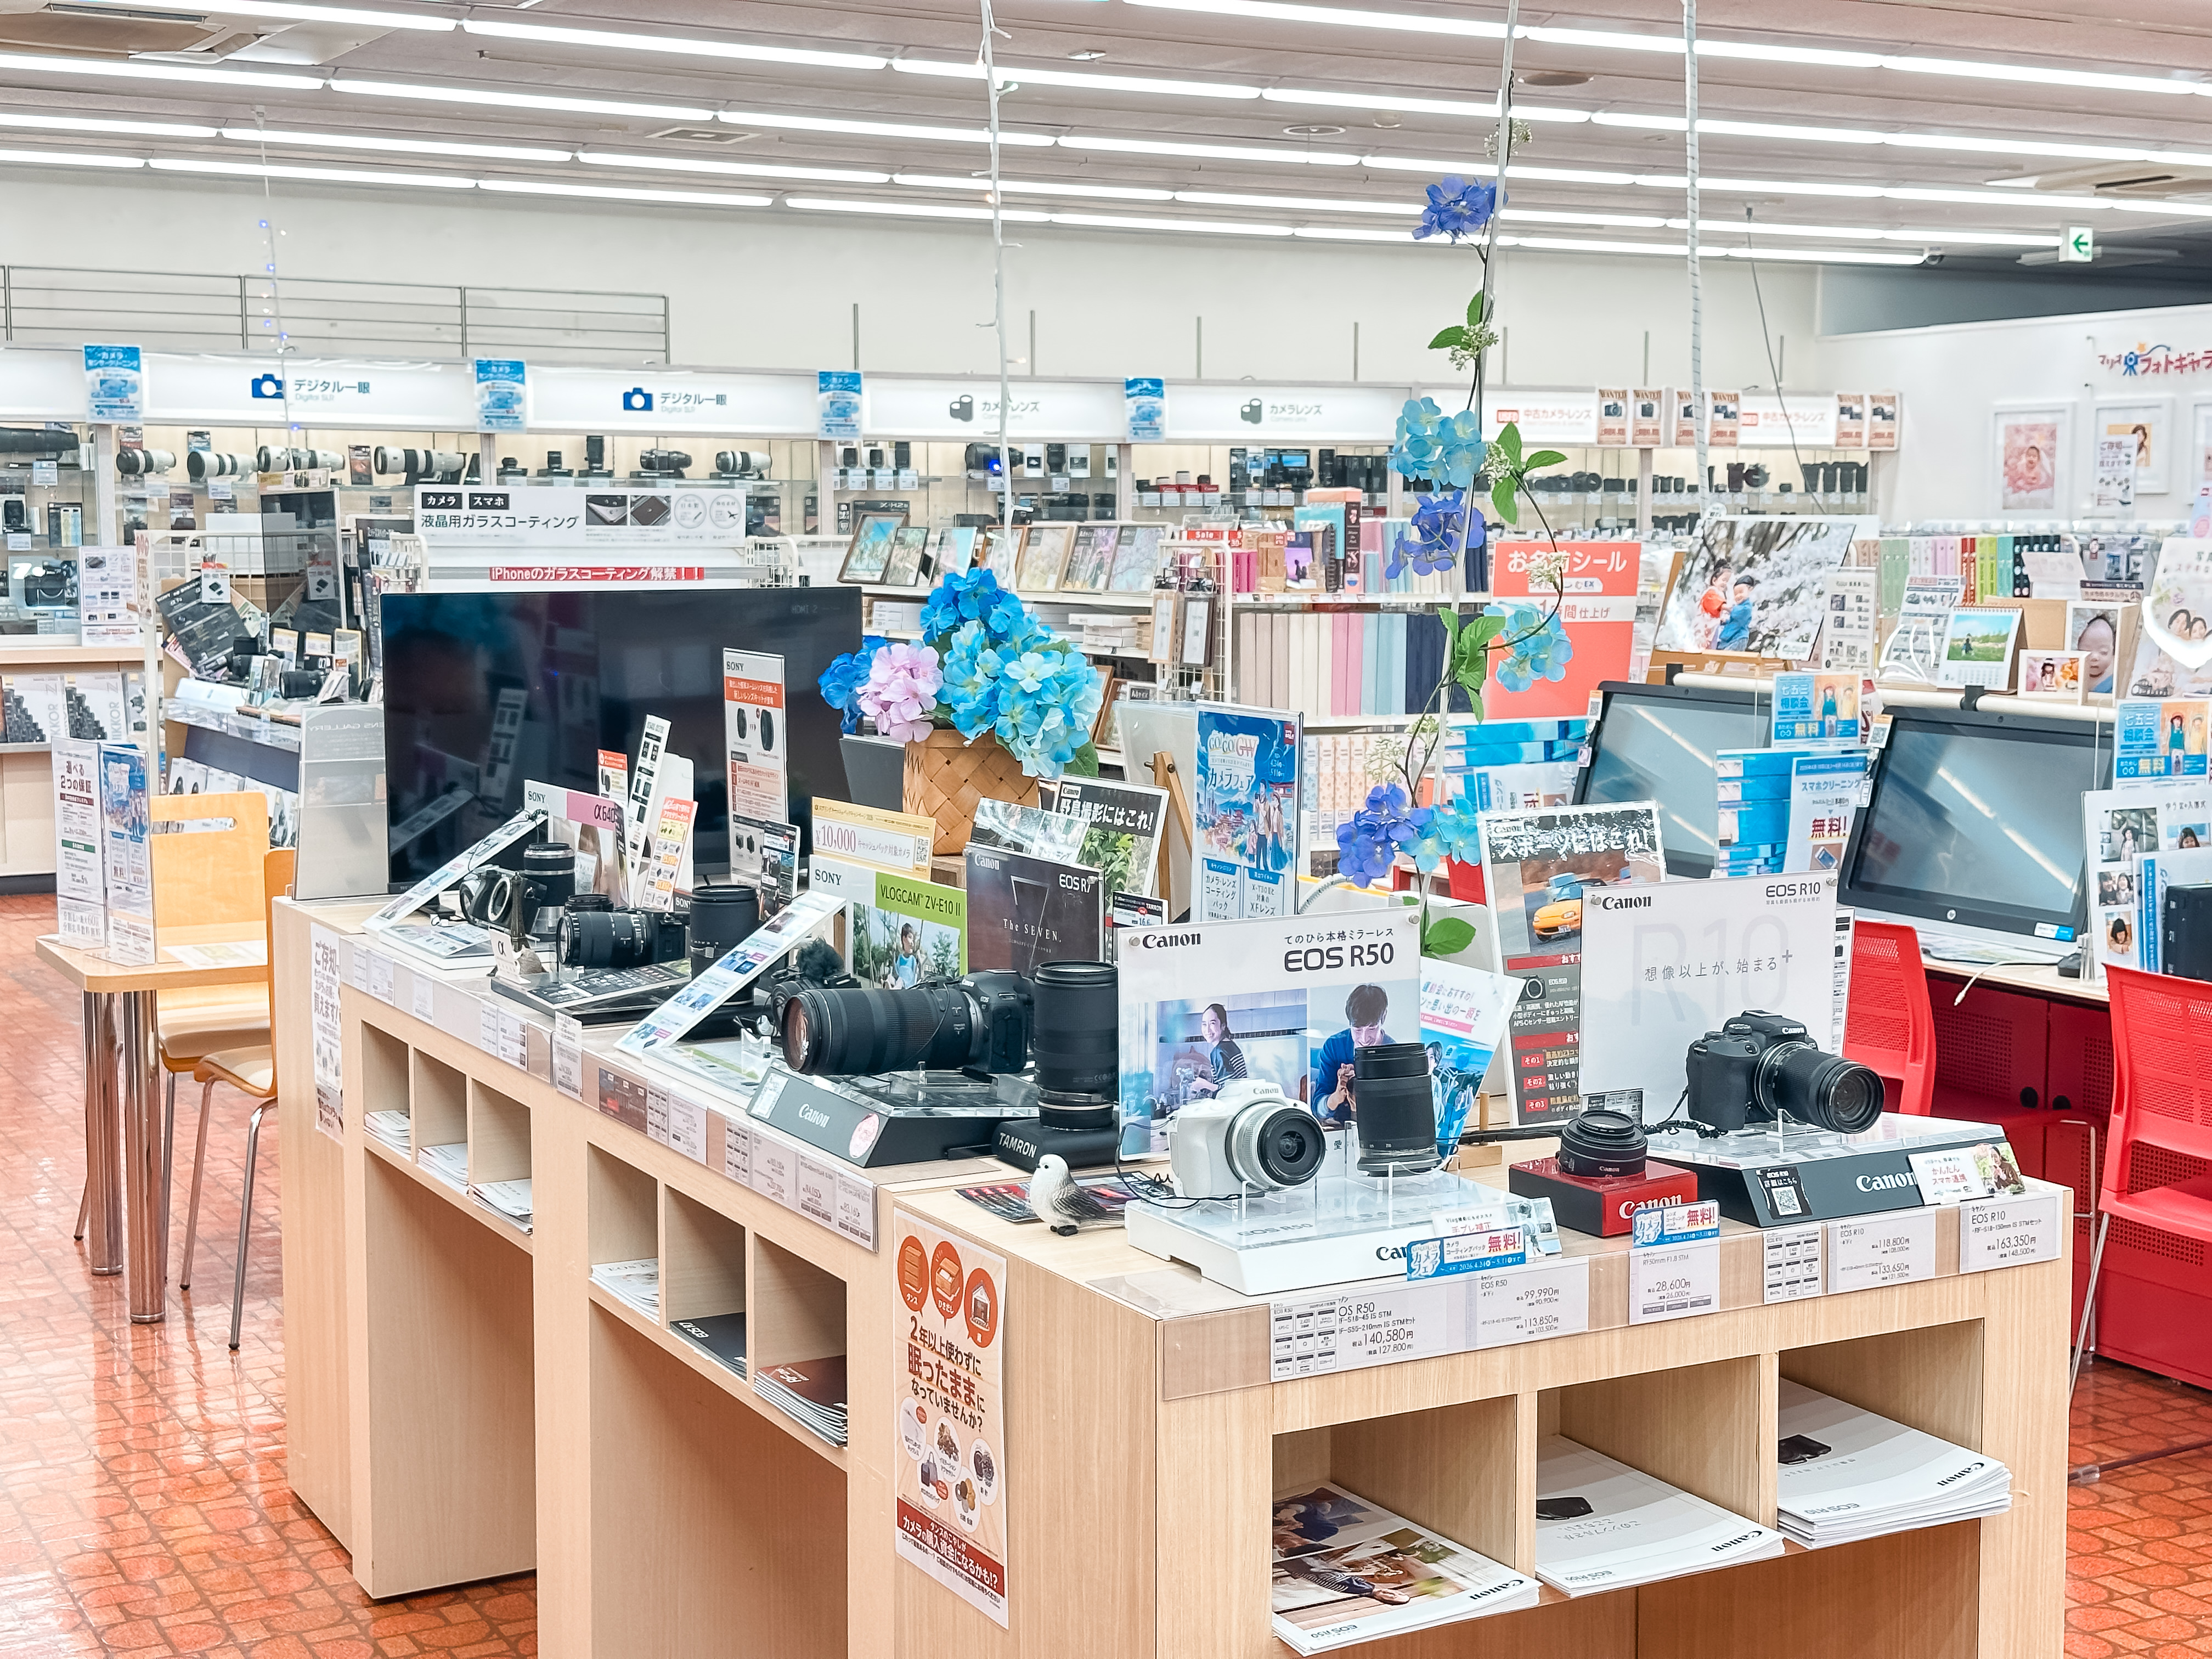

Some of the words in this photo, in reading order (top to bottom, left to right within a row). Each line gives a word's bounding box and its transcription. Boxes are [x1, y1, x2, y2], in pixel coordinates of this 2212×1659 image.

[295, 380, 370, 394] デジタル一眼
[661, 393, 727, 405] デジタル一眼
[1600, 391, 1627, 400] WANTED
[1635, 392, 1662, 400] WANTED
[982, 402, 1040, 412] カメレンズ
[1270, 405, 1323, 415] カメラレンズ
[427, 495, 456, 506] カメラ
[473, 495, 504, 506] スマホ
[421, 514, 579, 529] 液晶用ガラスコーティング
[726, 661, 744, 672] SONY
[1781, 684, 1810, 696] 七五三
[2125, 713, 2154, 726] 七五三
[1209, 768, 1255, 791] カメラフェア
[1801, 780, 1861, 792] スマホクリーニング
[528, 791, 546, 803] SONY
[1493, 824, 1522, 833] Canon
[1811, 815, 1847, 838] 無料!
[815, 824, 856, 853] ¥10,000
[974, 854, 1000, 871] Canon
[1059, 873, 1080, 891] EOS
[815, 869, 841, 885] SONY
[926, 895, 953, 913] ZV-E10
[956, 904, 966, 916] II
[1206, 886, 1236, 900] コーティング
[1766, 884, 1797, 898] EOS
[1800, 882, 1821, 895] R10
[1213, 901, 1228, 911] パック
[1251, 902, 1276, 916] XFレンズ
[1602, 895, 1651, 911] Canon
[1003, 918, 1023, 932] The
[1142, 932, 1201, 950] Canon
[1284, 927, 1394, 945] てのひら本格ミラーレス
[1284, 947, 1344, 972] EOS
[1350, 942, 1394, 967] R50
[1527, 1077, 1543, 1086] その2
[799, 1103, 830, 1128] Canon
[999, 1133, 1037, 1158] TAMRON
[1932, 1165, 1960, 1175] かんたん
[1855, 1172, 1917, 1193] Canon
[1620, 1193, 1683, 1219] Canon
[1687, 1206, 1716, 1227] 無料!
[1972, 1213, 1988, 1223] EOS
[1991, 1211, 2005, 1221] R10
[1238, 1228, 1280, 1237] EOS
[1282, 1223, 1313, 1231] R50
[1854, 1228, 1864, 1236] R10
[1487, 1231, 1521, 1253] 無料!
[1996, 1234, 2036, 1250] 163,350円
[1414, 1250, 1438, 1265] カメラ
[1481, 1282, 1494, 1290] EOS
[1496, 1279, 1508, 1288] R50
[1656, 1278, 1690, 1292] 28,600円
[906, 1293, 918, 1306] タンス
[1524, 1287, 1559, 1300] 99,990円
[1339, 1306, 1356, 1317] OS
[1357, 1302, 1375, 1314] R50
[1525, 1315, 1559, 1328] 113,850円
[1364, 1329, 1414, 1346] 140,580円
[910, 1316, 981, 1376] 2年以上使わずに
[908, 1342, 985, 1414] 眠ったままに
[912, 1378, 983, 1432] なっていませんか?
[1937, 1462, 1985, 1486] Canon
[1711, 1531, 1763, 1551] Canon
[1469, 1579, 1525, 1601] Canon
[1311, 1629, 1330, 1638] R50
[1330, 1624, 1358, 1634] EOS
